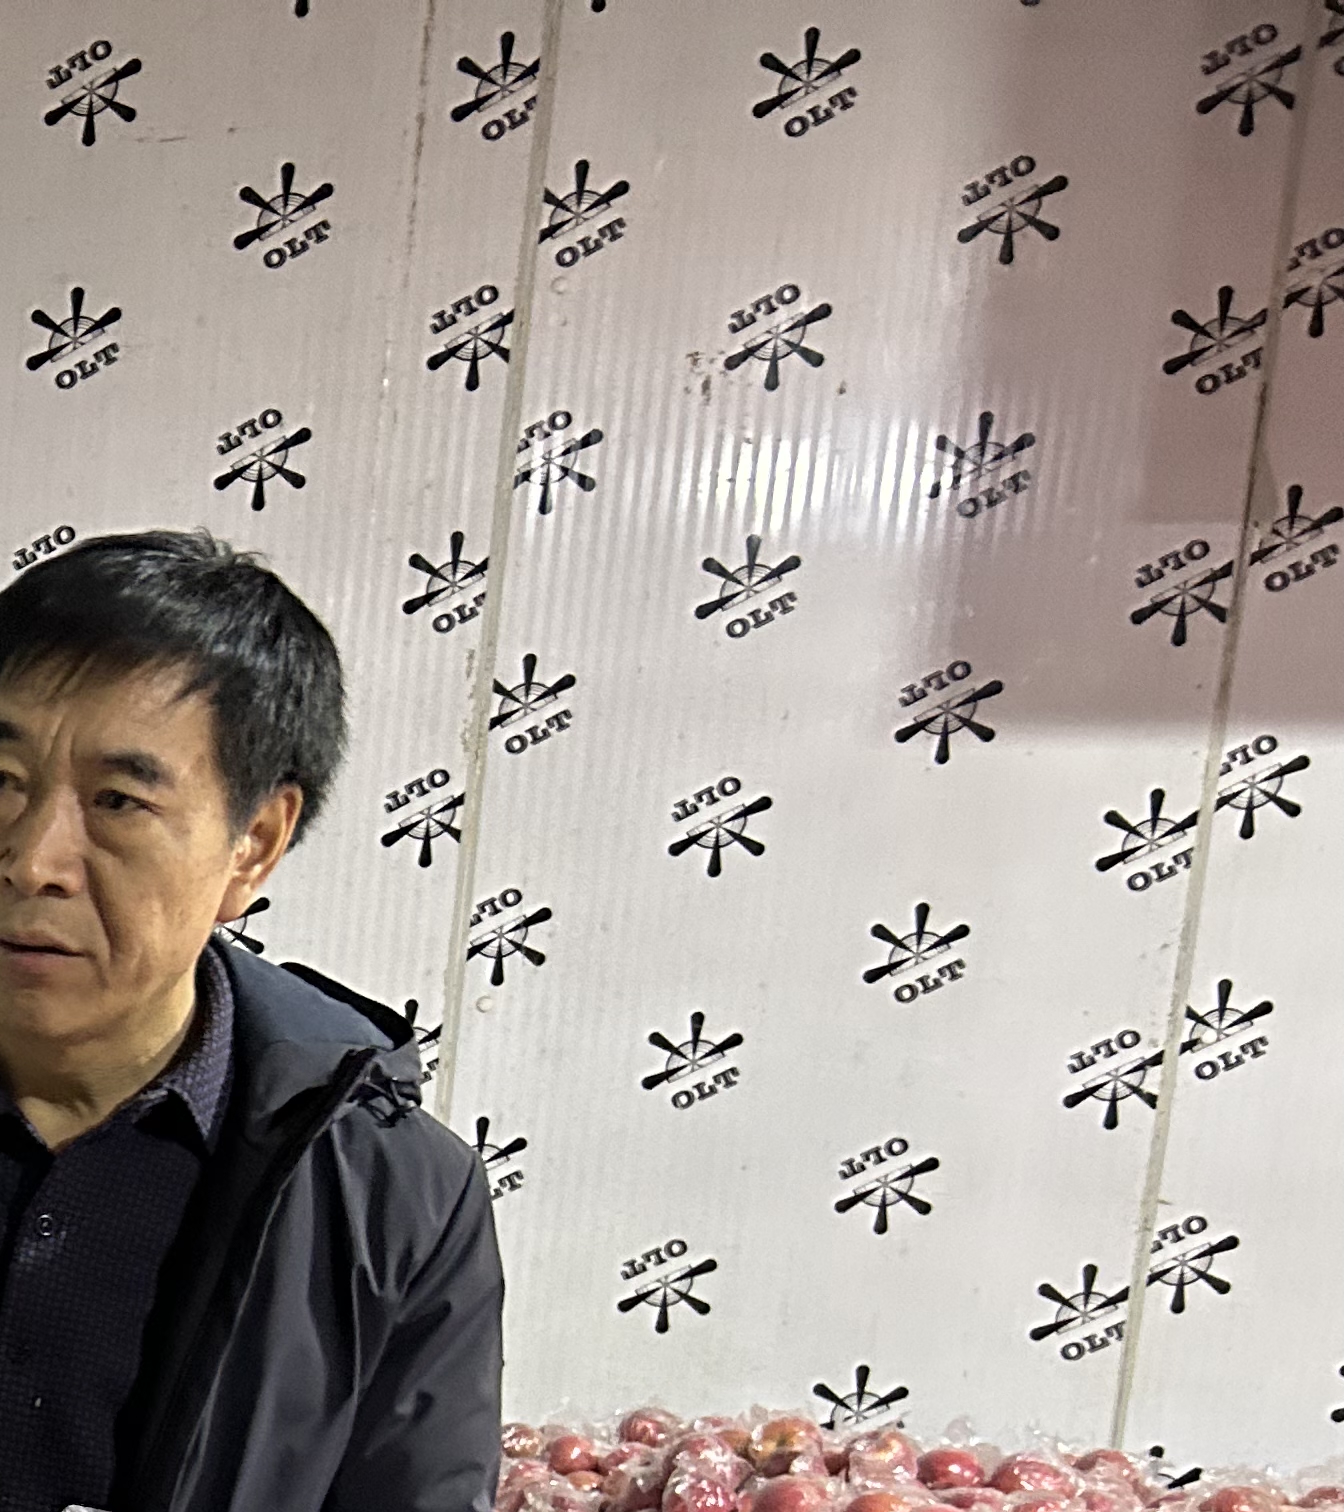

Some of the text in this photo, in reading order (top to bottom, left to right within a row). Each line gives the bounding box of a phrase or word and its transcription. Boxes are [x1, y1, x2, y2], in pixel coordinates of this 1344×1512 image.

[46, 40, 112, 89] OLT
[1201, 23, 1277, 75] OLT
[784, 87, 858, 137] OLT
[962, 155, 1036, 206] OLT
[264, 220, 331, 269] OLT
[555, 218, 626, 268] OLT
[1287, 228, 1344, 272] OL
[429, 284, 500, 334] OLT
[728, 284, 800, 334] OLT
[55, 343, 119, 389] OLT
[216, 408, 282, 455] OLT
[956, 470, 1031, 519] OLT
[12, 526, 76, 570] OLT
[1135, 538, 1210, 589] OLT
[1263, 544, 1340, 592] OLT
[725, 591, 798, 638] OLT
[898, 660, 972, 708] OLT
[505, 709, 572, 755] OLT
[383, 768, 450, 813] OLT
[671, 776, 742, 822] OLT
[893, 959, 966, 1003] OLT
[1067, 1029, 1141, 1074] OLT
[1193, 1036, 1268, 1080] OLT
[671, 1067, 740, 1110] OLT
[838, 1137, 910, 1180] OLT
[621, 1239, 687, 1281] OLT
